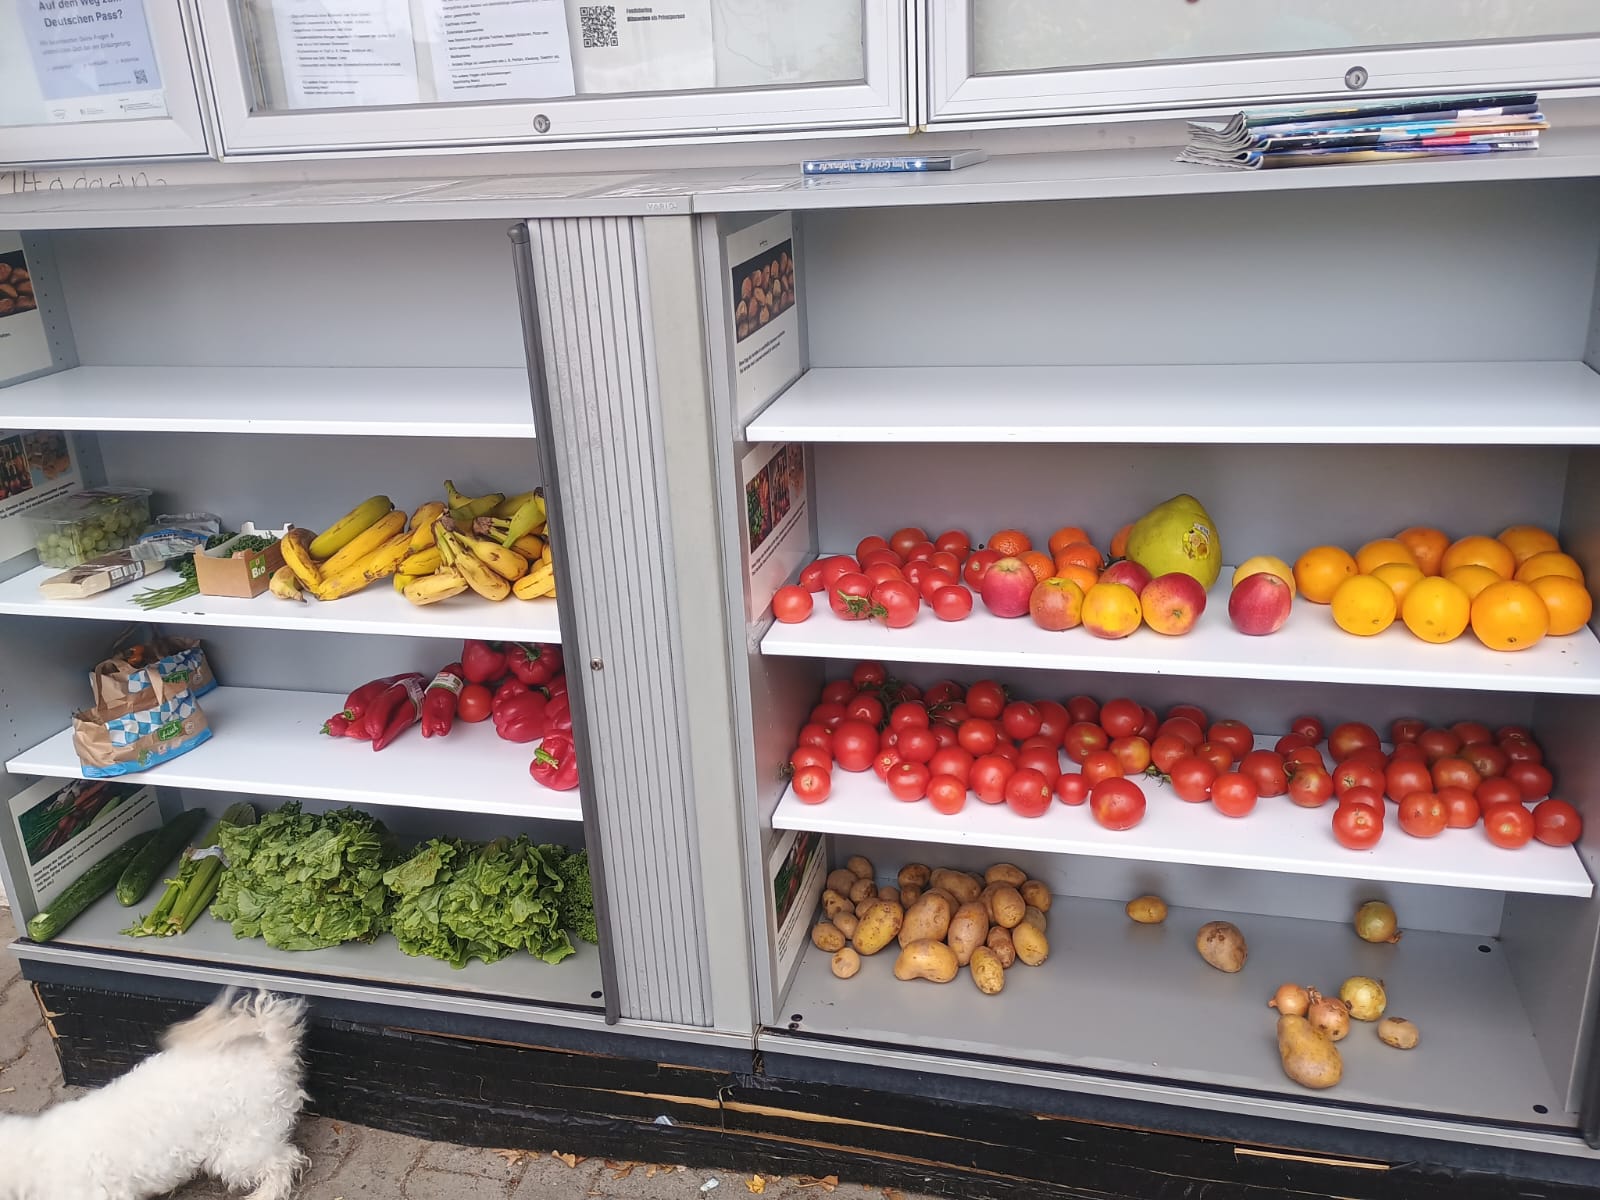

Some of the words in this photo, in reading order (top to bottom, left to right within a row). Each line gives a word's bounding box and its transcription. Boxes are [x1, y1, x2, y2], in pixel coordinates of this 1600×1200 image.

[39, 1, 56, 11] Auf
[58, 0, 79, 9] dem
[44, 14, 95, 28] Deutschen
[95, 9, 123, 21] Pass?
